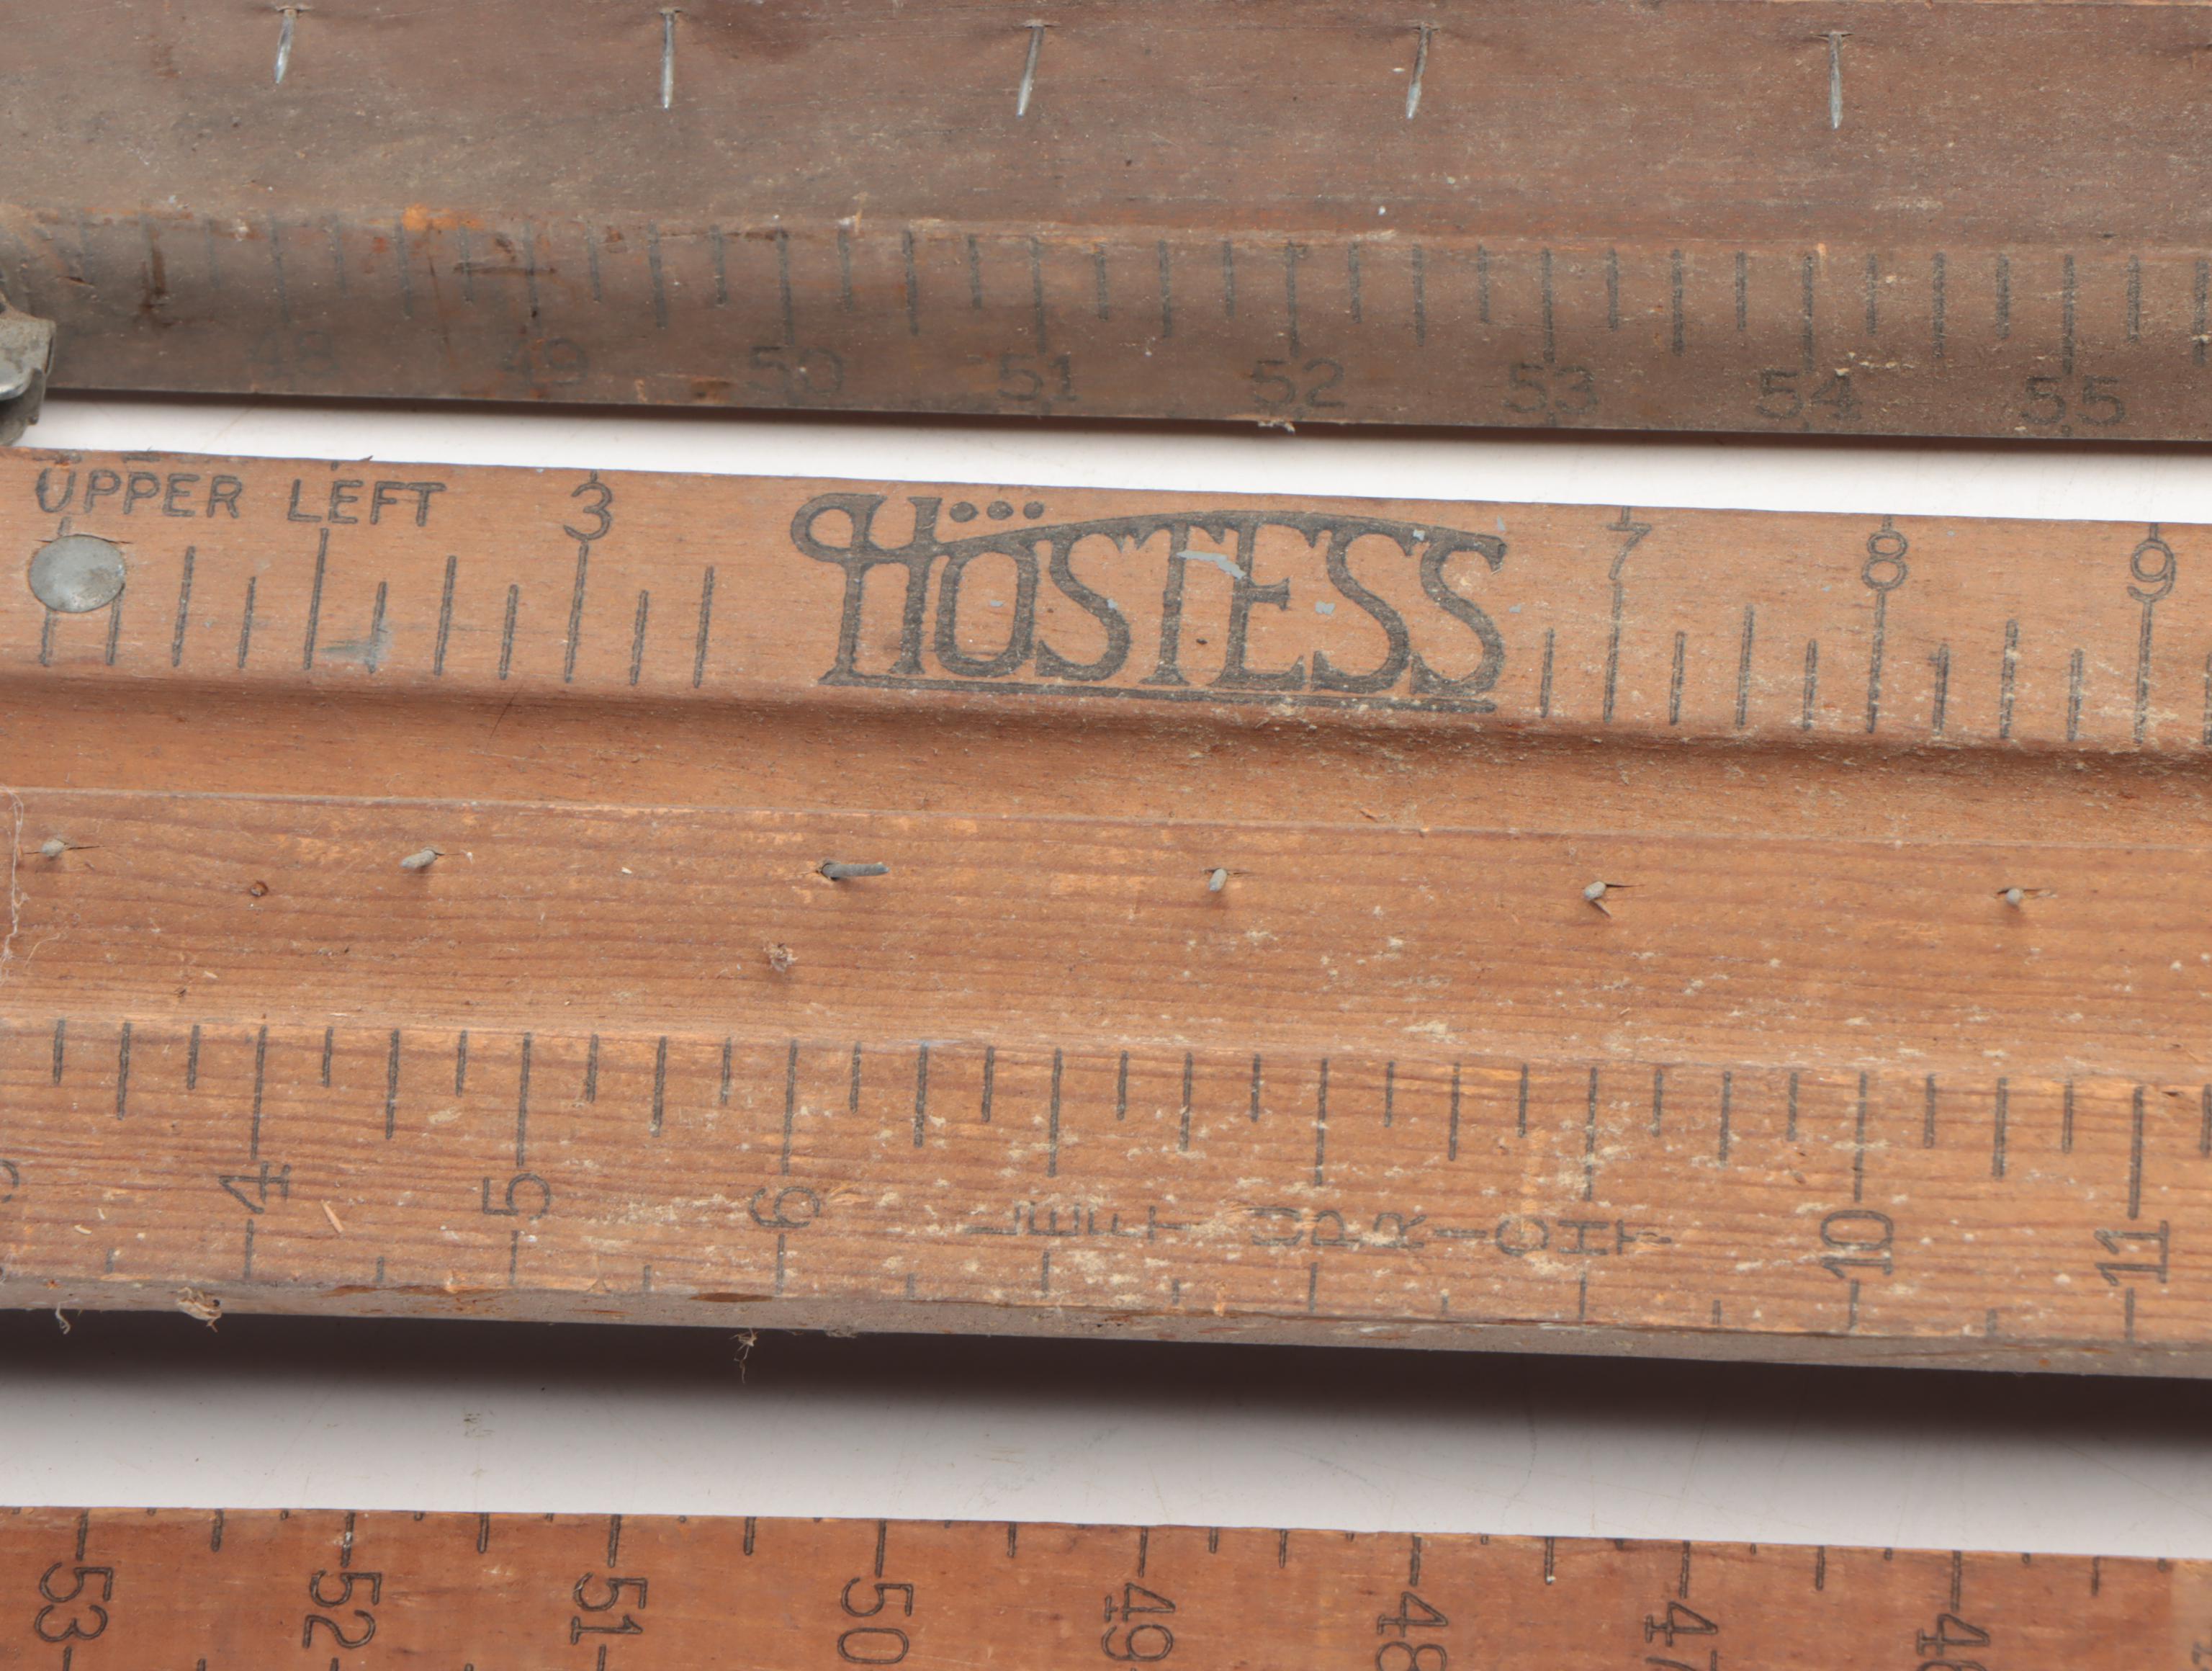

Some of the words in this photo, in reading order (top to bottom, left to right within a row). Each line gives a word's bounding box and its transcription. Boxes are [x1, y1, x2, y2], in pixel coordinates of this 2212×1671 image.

[746, 346, 845, 395] 50
[997, 353, 1079, 404] 51
[1249, 357, 1346, 410] 52
[1502, 363, 1599, 416] 53
[1754, 369, 1863, 421] 54
[2025, 376, 2128, 427] 55
[35, 468, 245, 519] UPPER
[289, 478, 447, 527] LEFT
[562, 480, 613, 542] 3
[1609, 523, 1651, 581] 7
[1861, 530, 1909, 593] 8
[2128, 537, 2178, 602] 9
[789, 492, 1509, 702] HOSTESS
[217, 1160, 292, 1214] 4
[481, 1173, 552, 1221] 5
[748, 1185, 821, 1228] 6
[1820, 1209, 1894, 1278] 10
[2093, 1219, 2170, 1286] 11
[34, 1562, 114, 1643] 53
[301, 1568, 383, 1649] 52
[569, 1572, 649, 1646] 51
[836, 1576, 914, 1665] 50
[1102, 1582, 1177, 1662] 49
